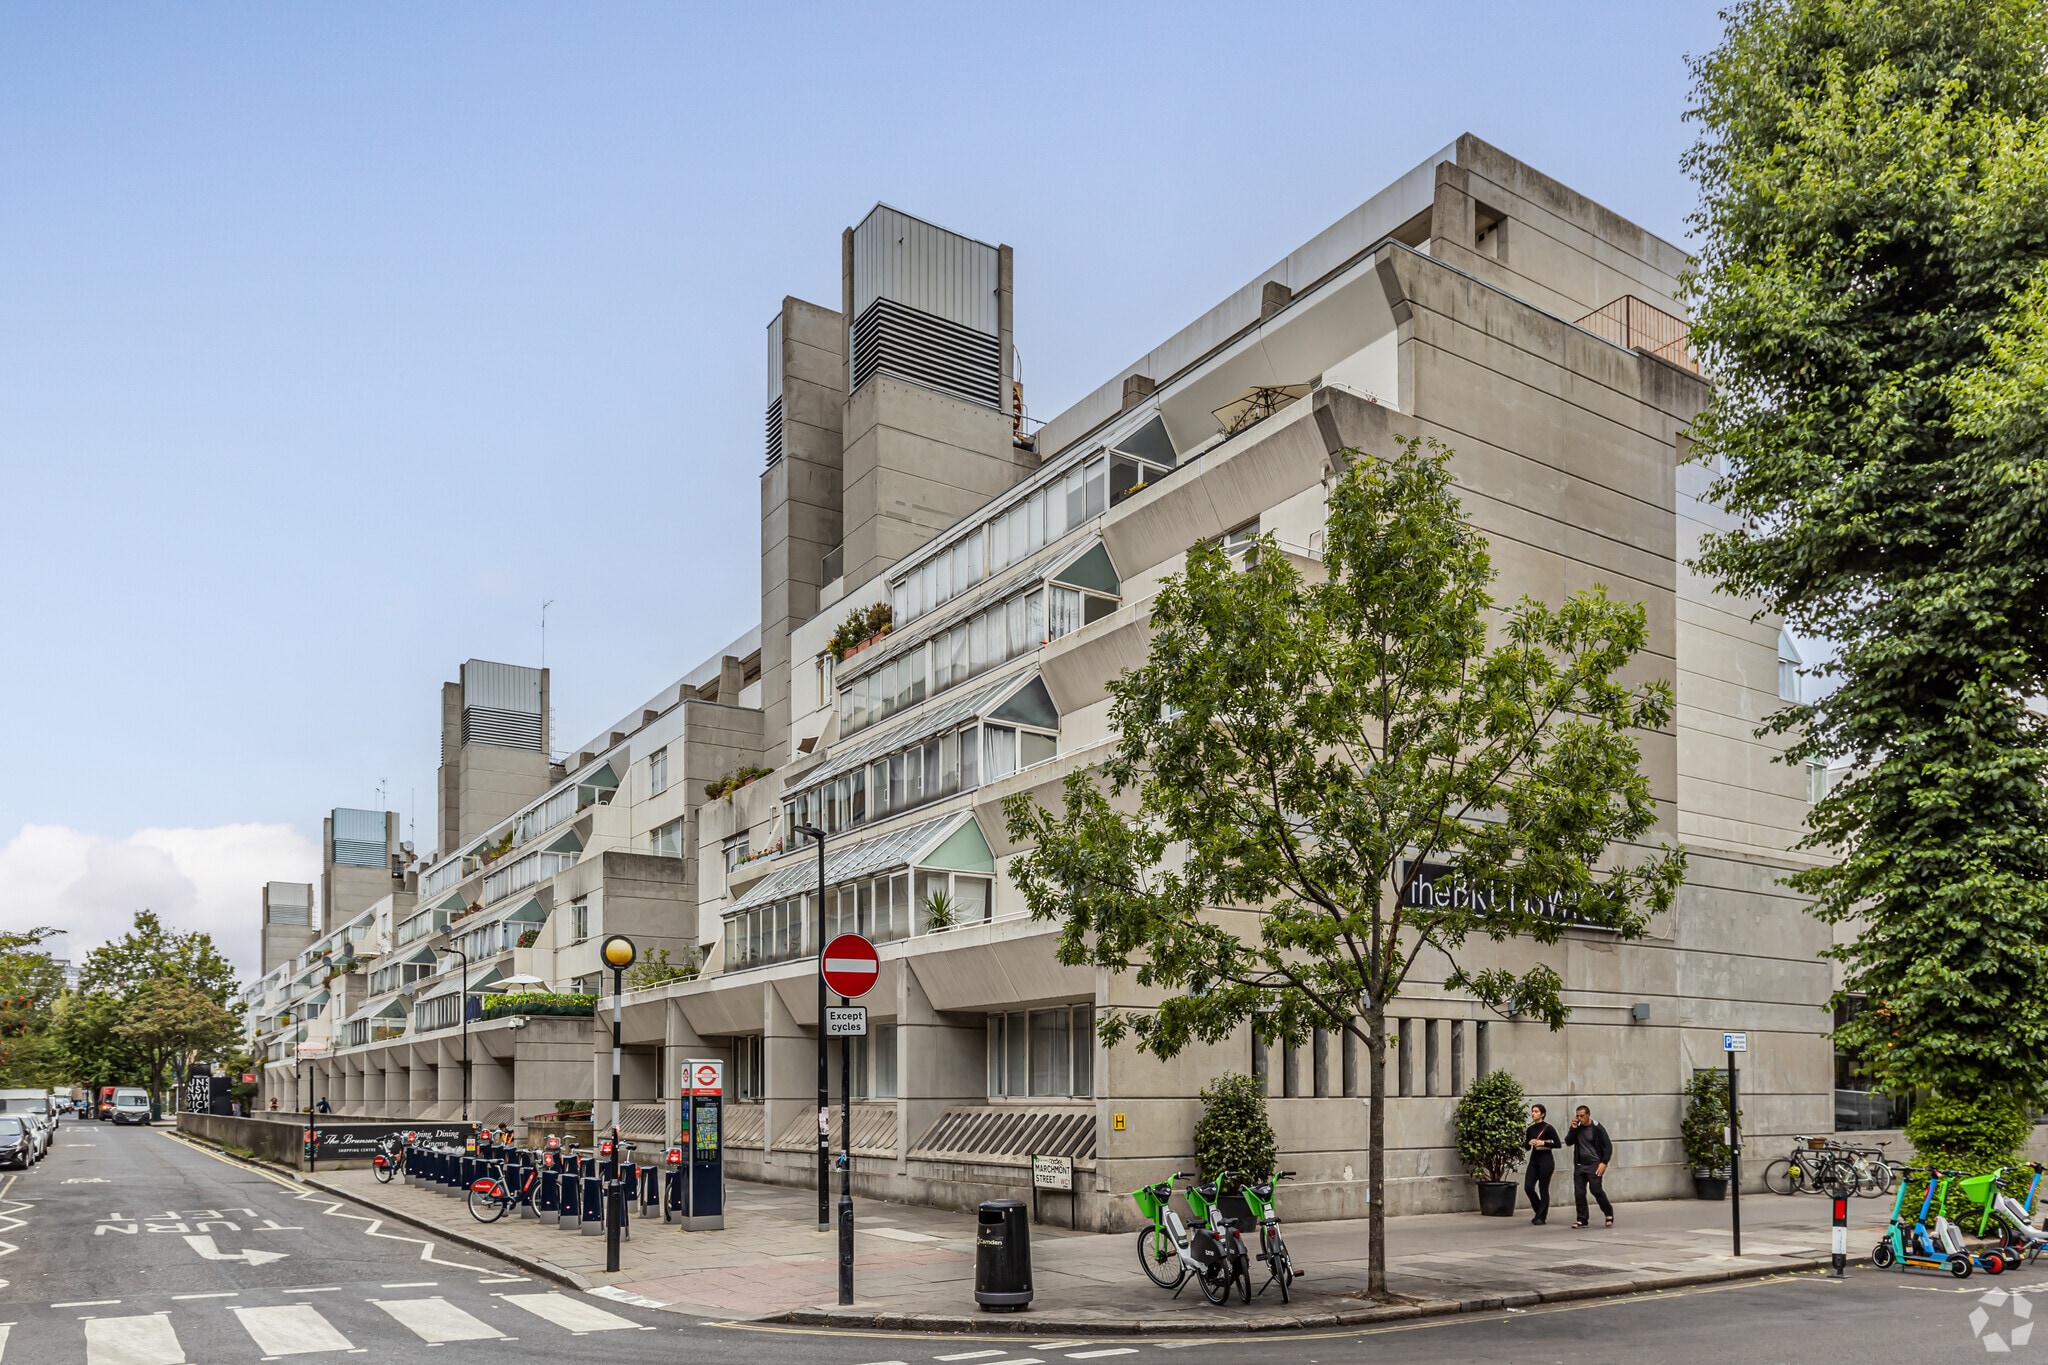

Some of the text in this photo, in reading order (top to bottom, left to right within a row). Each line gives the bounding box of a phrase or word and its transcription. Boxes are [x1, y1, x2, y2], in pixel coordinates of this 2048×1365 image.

[830, 1011, 863, 1021] Except
[831, 1022, 861, 1032] cycles
[1115, 1115, 1125, 1128] H
[435, 1129, 460, 1139] Dining
[323, 1134, 340, 1145] The
[422, 1139, 449, 1148] Cinema
[1035, 1164, 1070, 1175] MARCHMONT
[1035, 1174, 1056, 1184] STREET
[95, 1208, 258, 1222] LEFT
[94, 1219, 304, 1236] TURN
